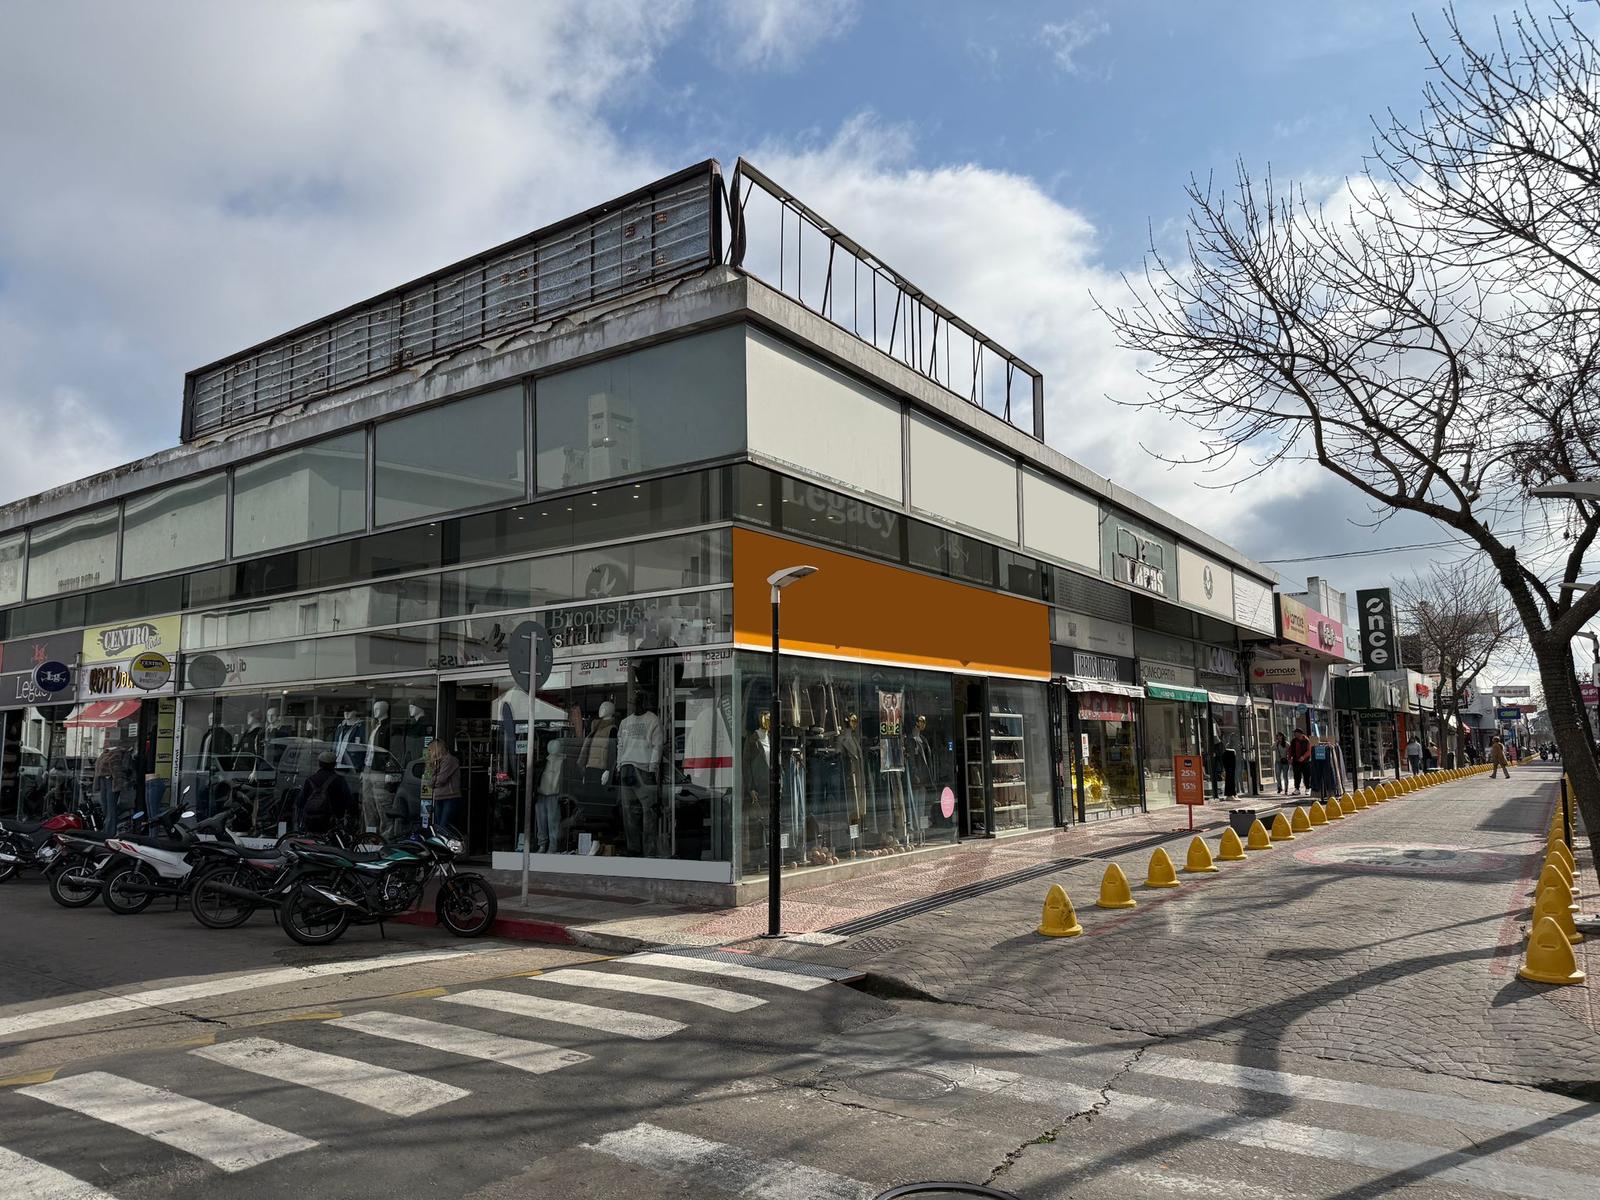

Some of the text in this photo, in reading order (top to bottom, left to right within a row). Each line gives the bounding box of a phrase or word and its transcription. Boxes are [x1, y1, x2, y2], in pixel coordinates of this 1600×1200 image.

[782, 478, 896, 538] Legacy
[1127, 560, 1164, 594] LBROS
[551, 598, 659, 630] Brooksfield
[104, 625, 149, 649] CENTRO
[15, 676, 52, 702] Lega
